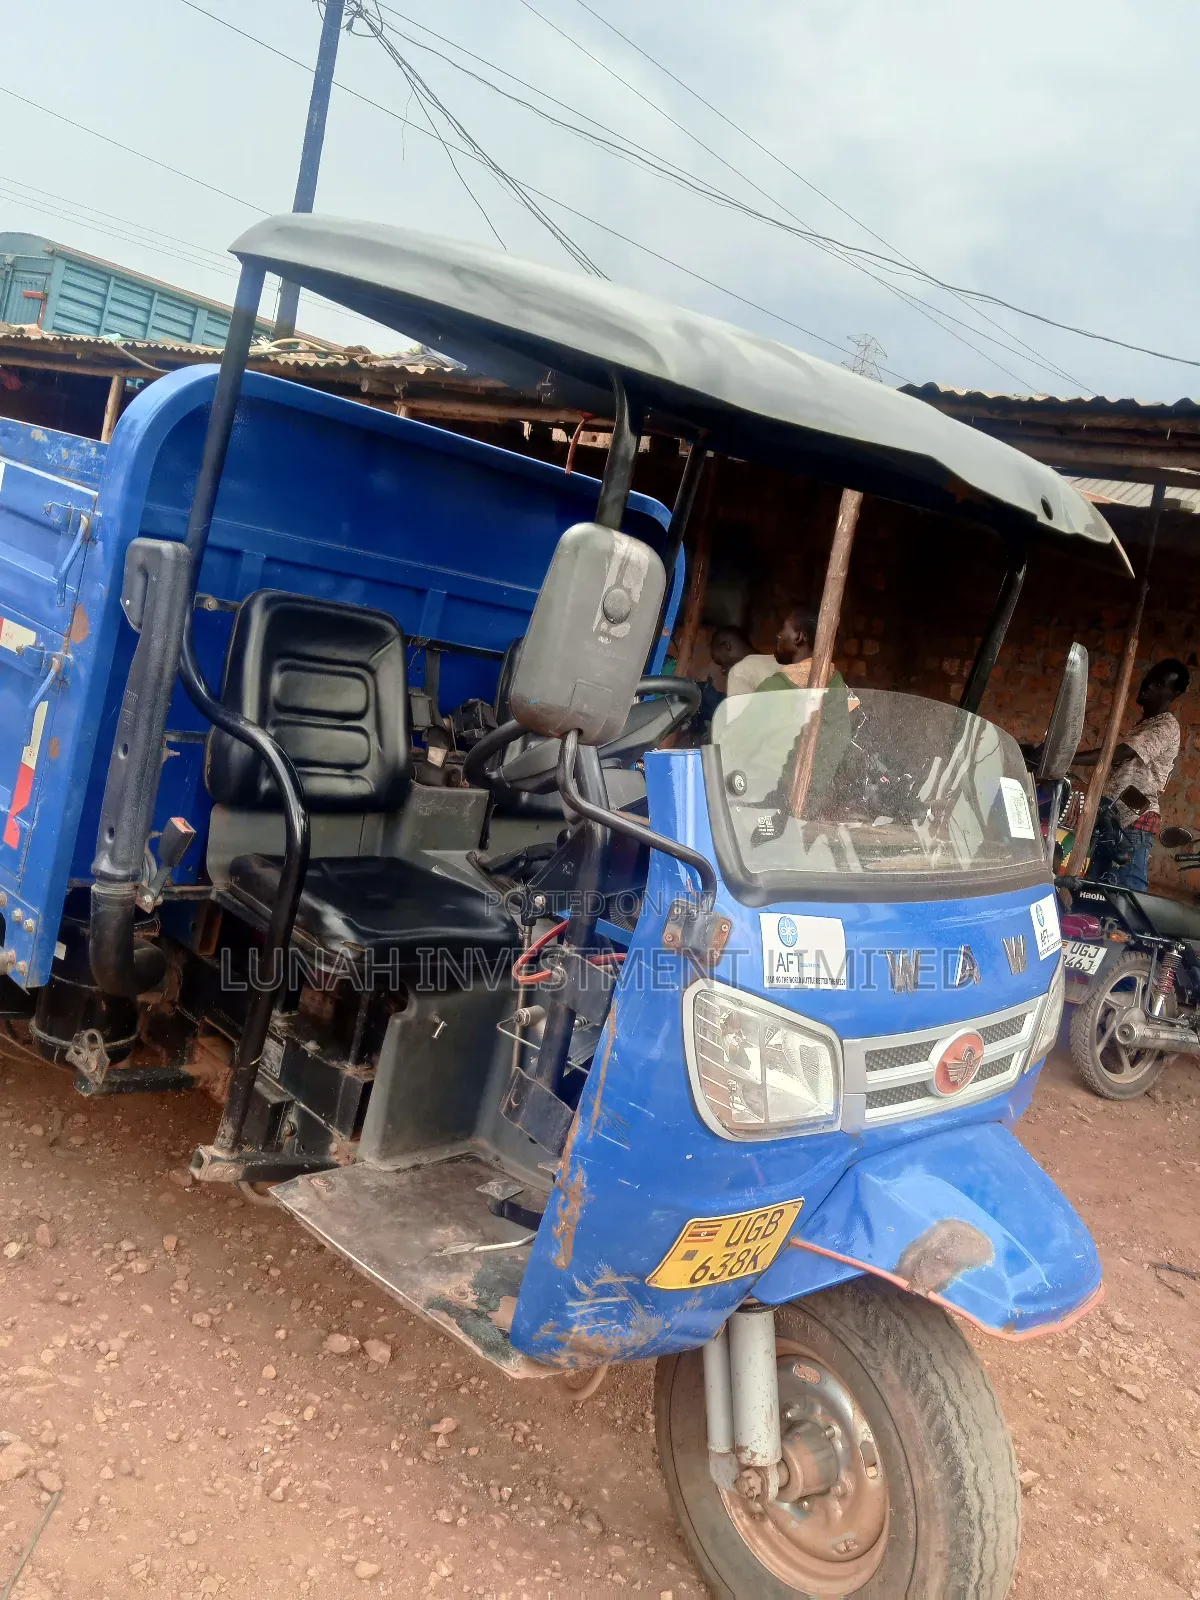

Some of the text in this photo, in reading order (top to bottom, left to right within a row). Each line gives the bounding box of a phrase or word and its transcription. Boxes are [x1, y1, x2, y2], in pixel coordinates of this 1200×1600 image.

[1079, 891, 1107, 902] HaoJu
[1070, 942, 1100, 959] UGJ
[725, 1208, 785, 1248] UGB
[689, 1241, 771, 1284] 638K
